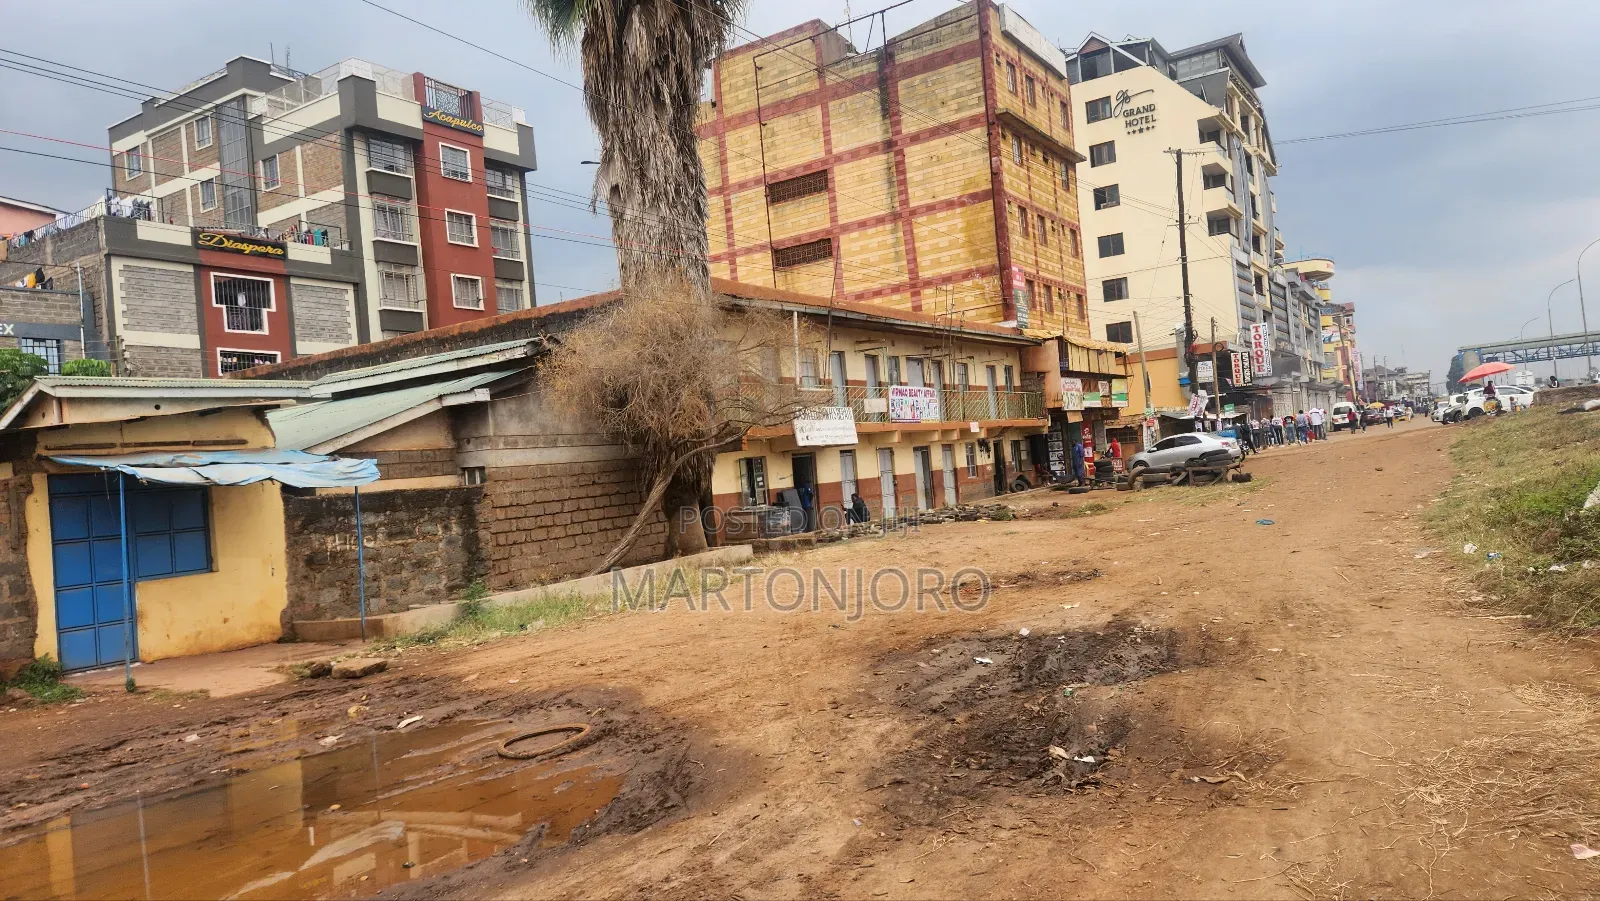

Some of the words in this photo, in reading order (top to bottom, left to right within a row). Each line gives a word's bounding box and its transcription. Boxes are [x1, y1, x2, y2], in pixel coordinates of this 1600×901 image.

[424, 109, 484, 131] Acapulco
[1123, 104, 1156, 118] GRAND
[1125, 114, 1157, 128] HOTEL
[198, 232, 284, 255] Diaspora
[1252, 325, 1266, 373] TORQUE
[1233, 353, 1242, 384] TORQUE
